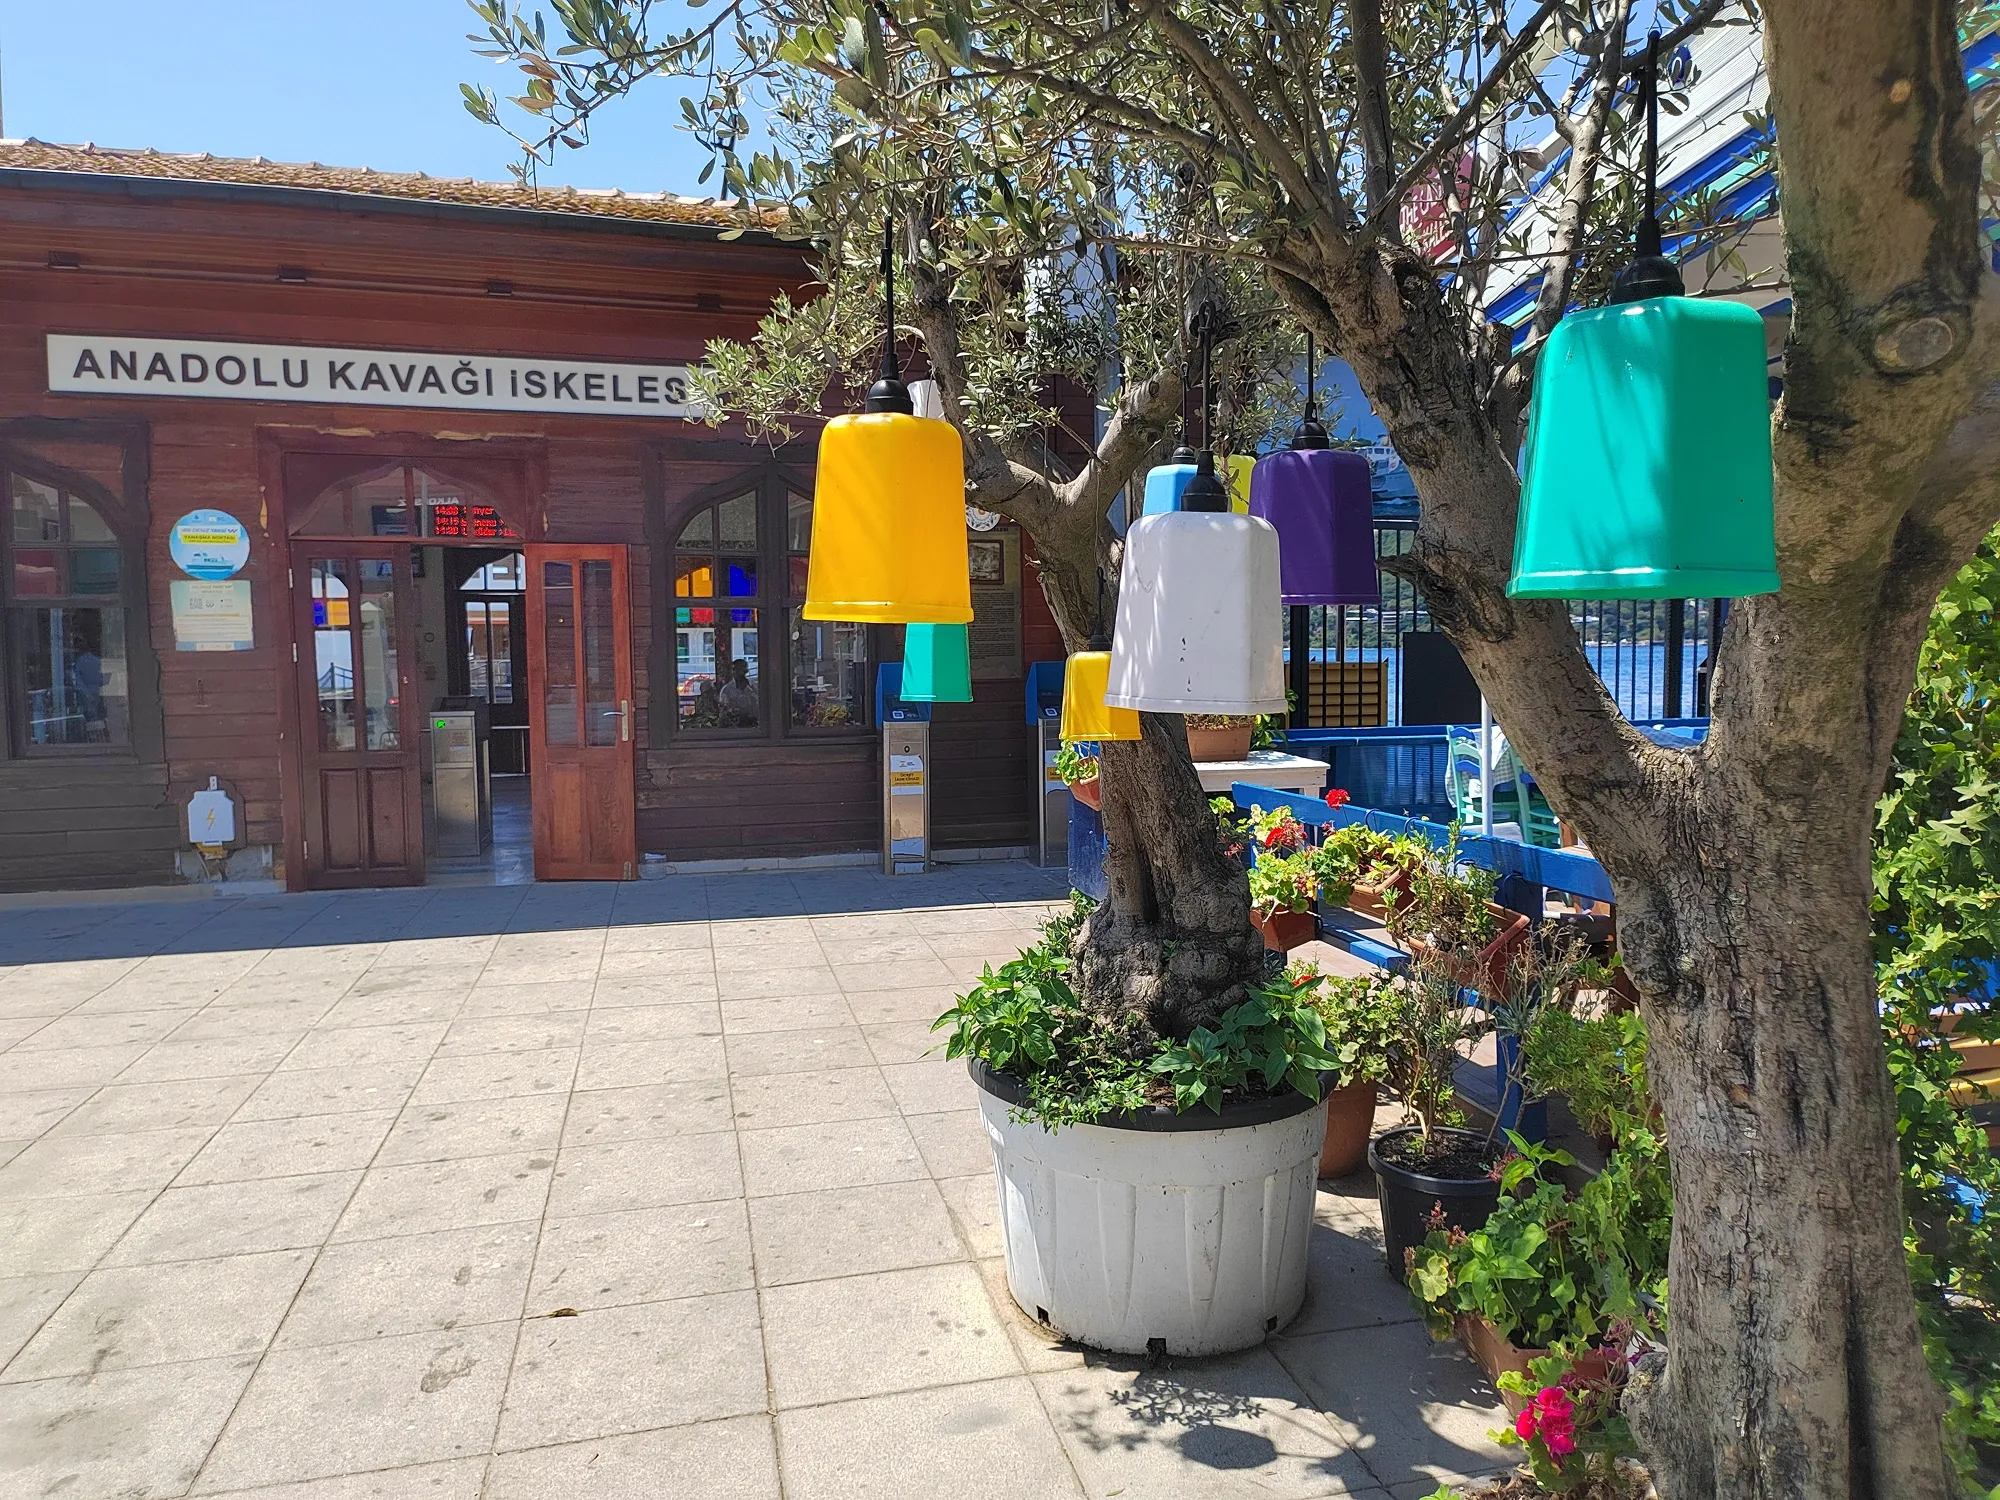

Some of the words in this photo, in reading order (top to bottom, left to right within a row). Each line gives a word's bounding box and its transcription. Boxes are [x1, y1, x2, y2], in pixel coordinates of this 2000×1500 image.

[72, 349, 309, 388] ANADOLU
[328, 360, 493, 397] KAVAĞI
[510, 369, 688, 405] İSKELES
